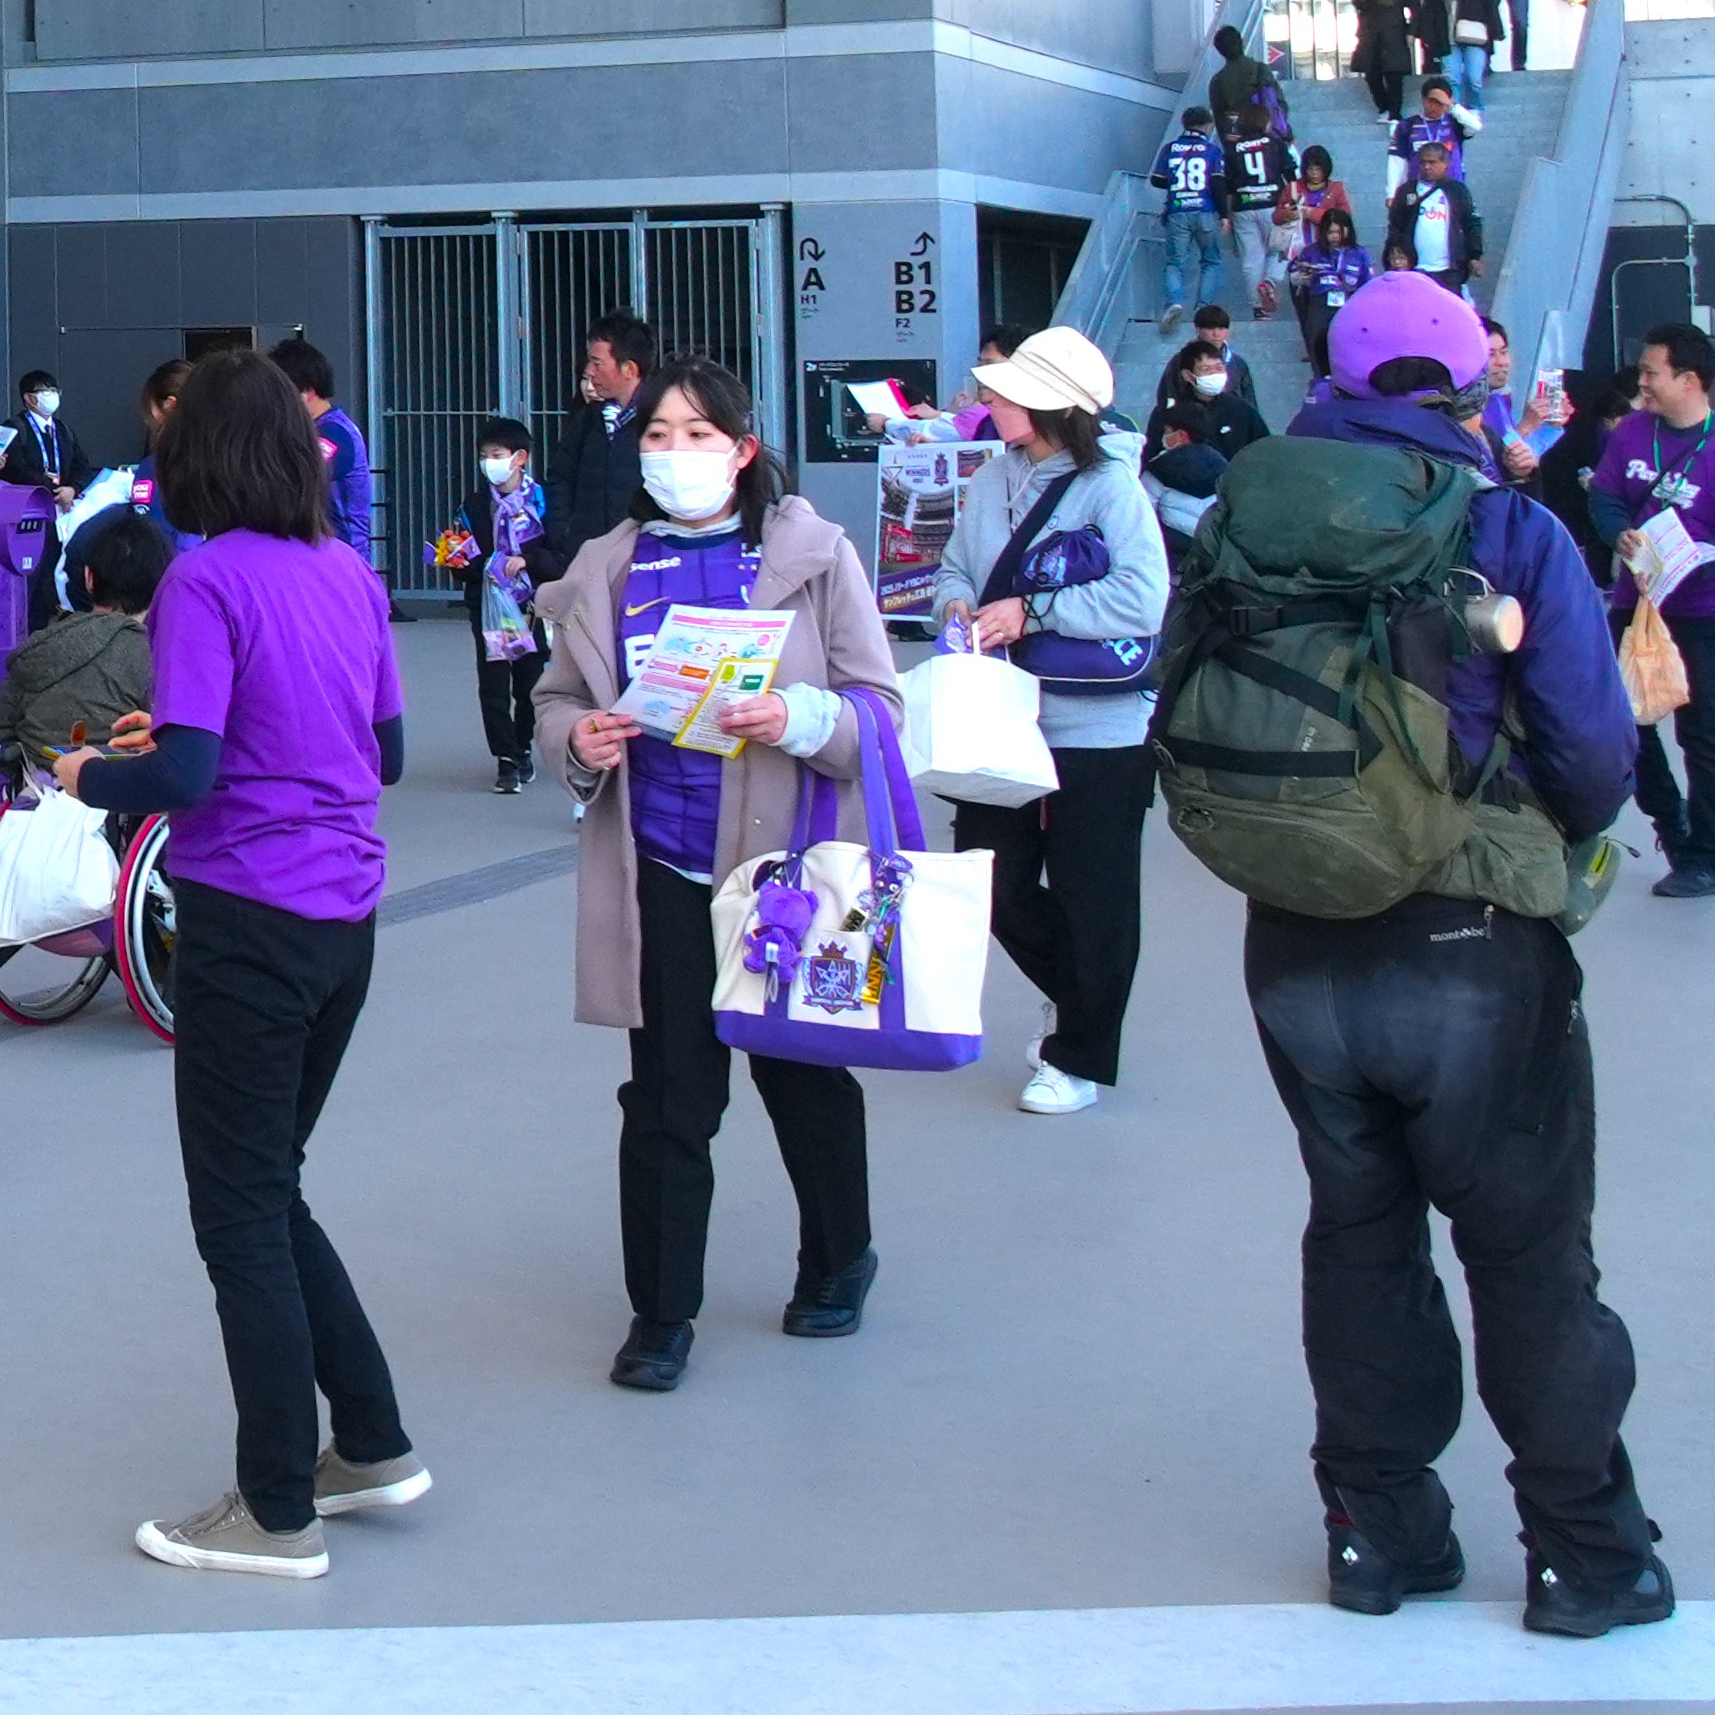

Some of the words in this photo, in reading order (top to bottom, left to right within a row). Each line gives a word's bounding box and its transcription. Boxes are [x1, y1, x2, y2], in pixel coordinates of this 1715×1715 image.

[1168, 157, 1207, 191] 38
[1244, 150, 1267, 184] 4
[801, 267, 826, 291] A
[894, 260, 932, 285] B1
[800, 294, 817, 304] H1
[895, 289, 937, 314] B2
[895, 317, 910, 328] F2
